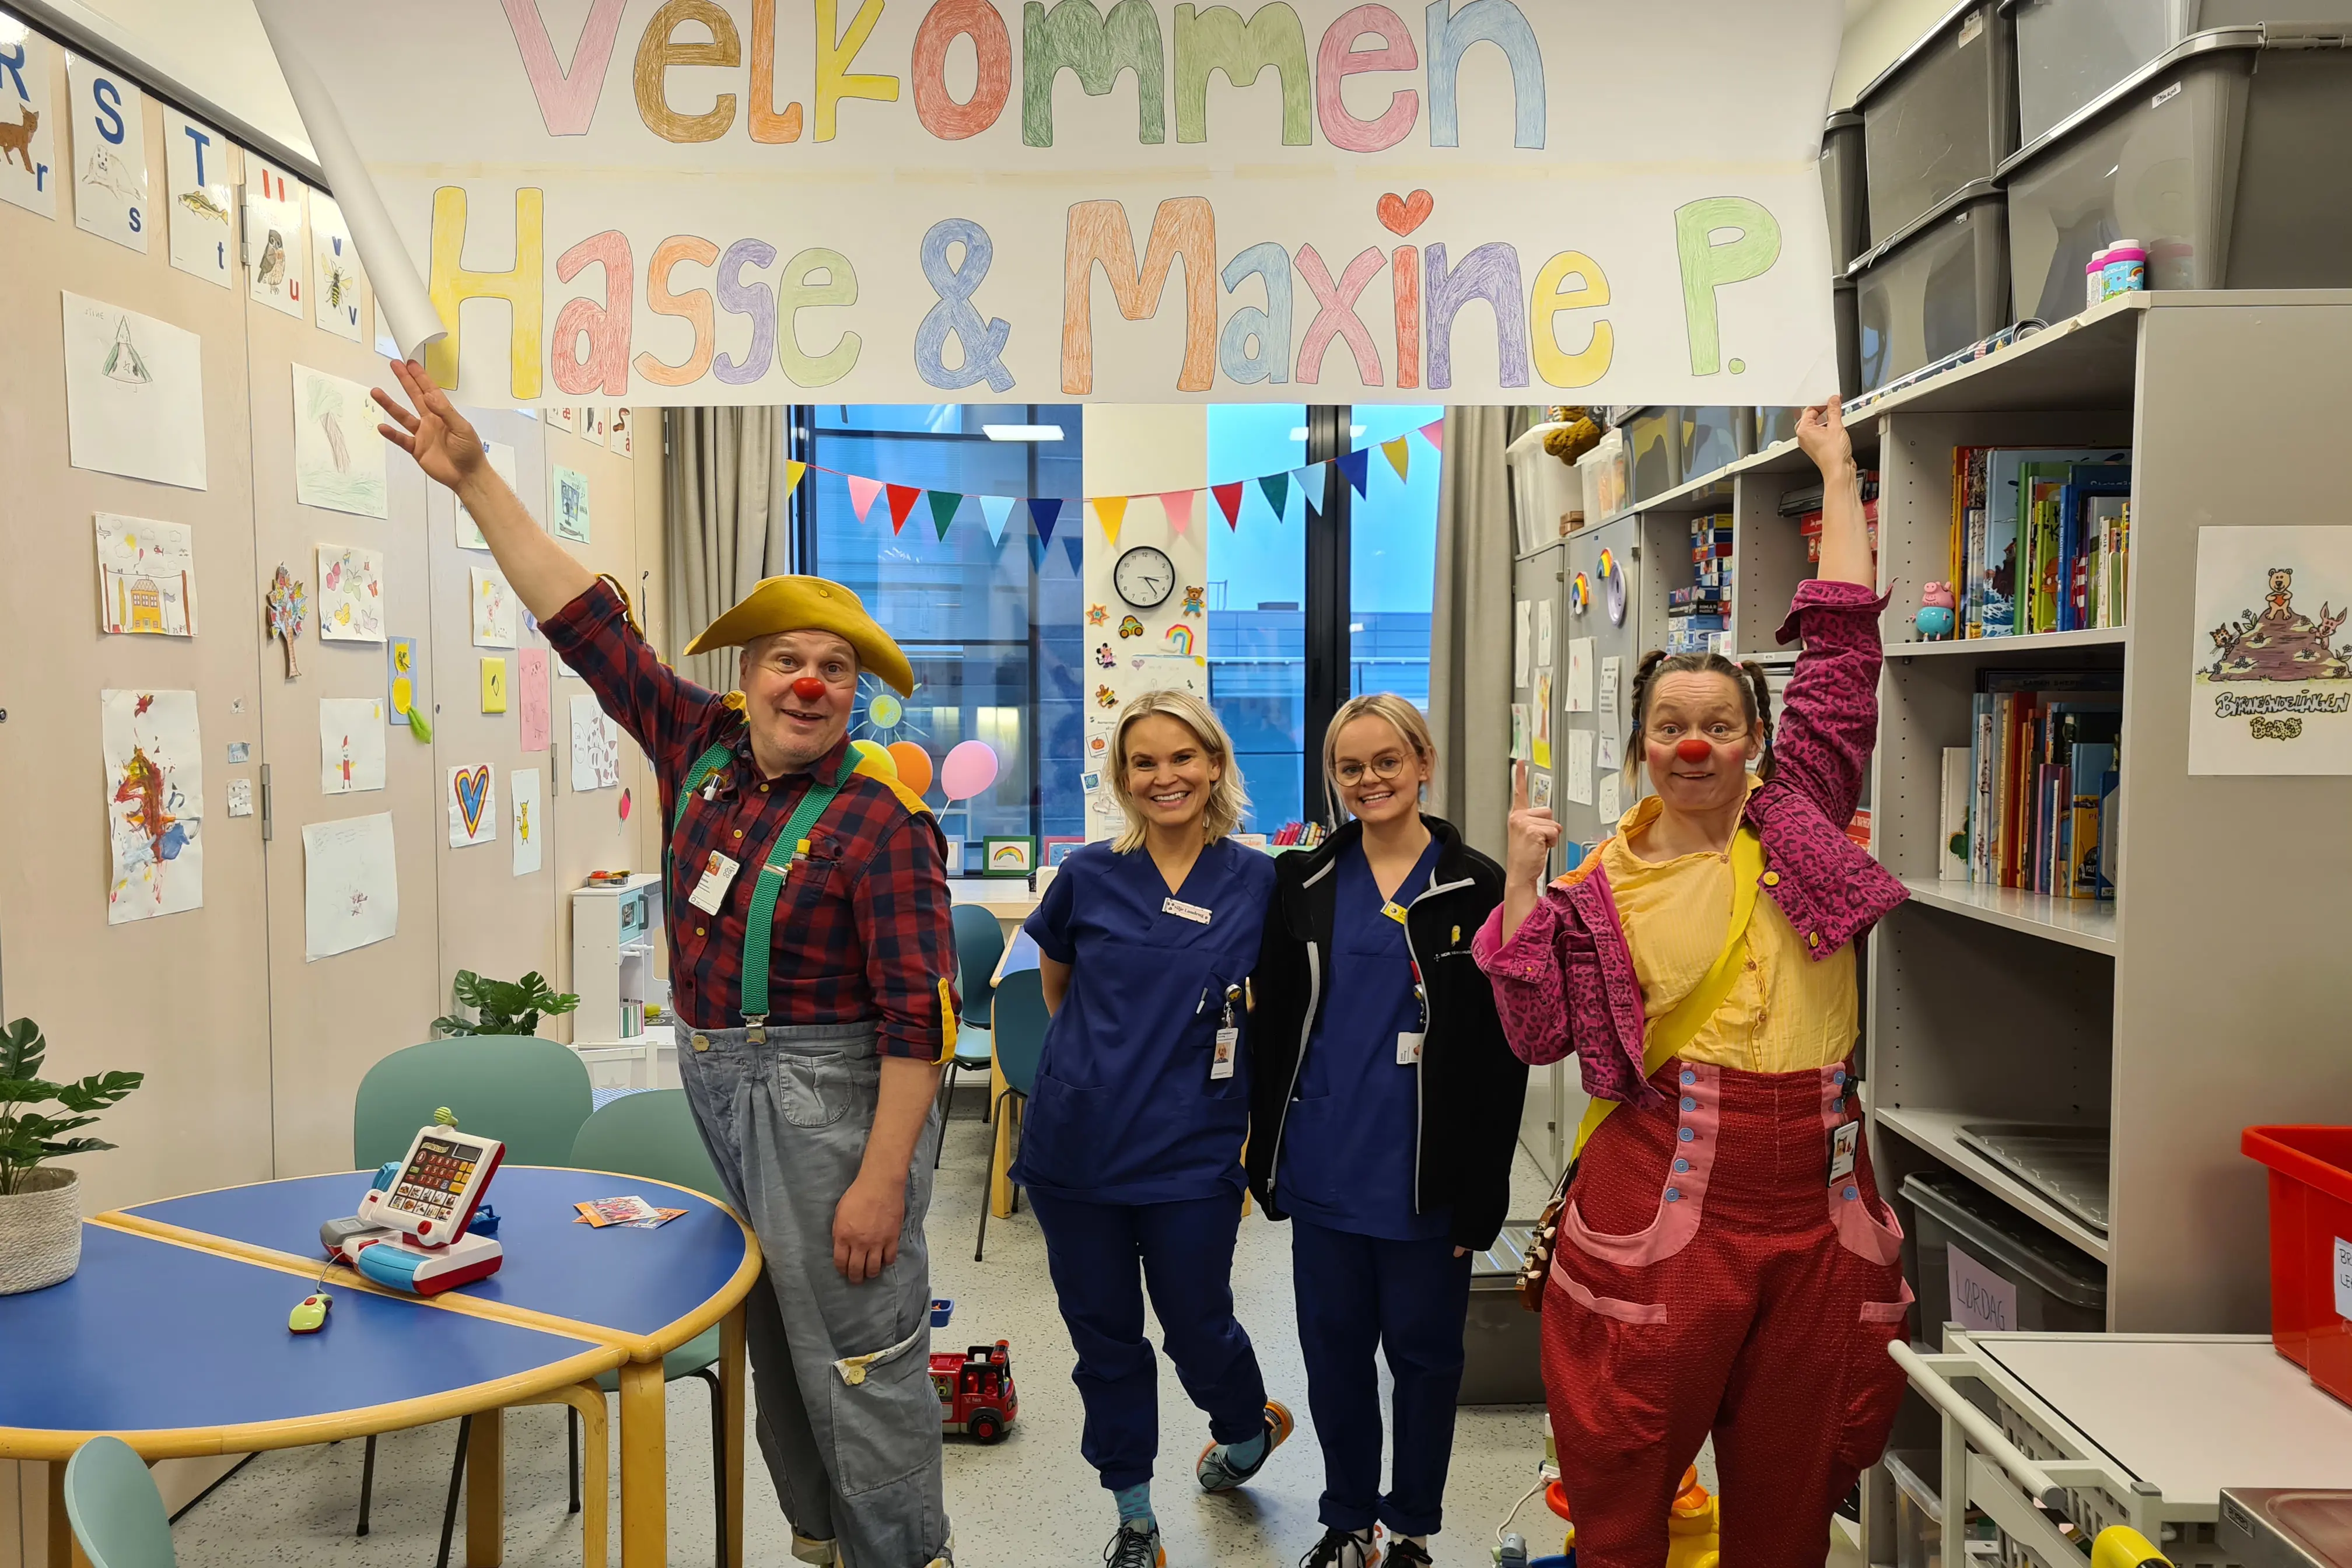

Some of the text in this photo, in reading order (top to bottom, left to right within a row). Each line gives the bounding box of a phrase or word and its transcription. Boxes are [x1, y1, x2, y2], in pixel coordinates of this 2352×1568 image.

[0, 44, 30, 102] R
[501, 0, 1546, 152] Velkommen
[93, 78, 125, 145] S
[37, 162, 48, 192] r
[185, 125, 210, 187] T
[129, 206, 141, 233] s
[218, 242, 224, 270] t
[289, 278, 299, 302] u
[348, 305, 357, 326] v
[424, 186, 1782, 400] Hasse & Maxine P.
[1956, 1270, 2005, 1331] LØRDAG
